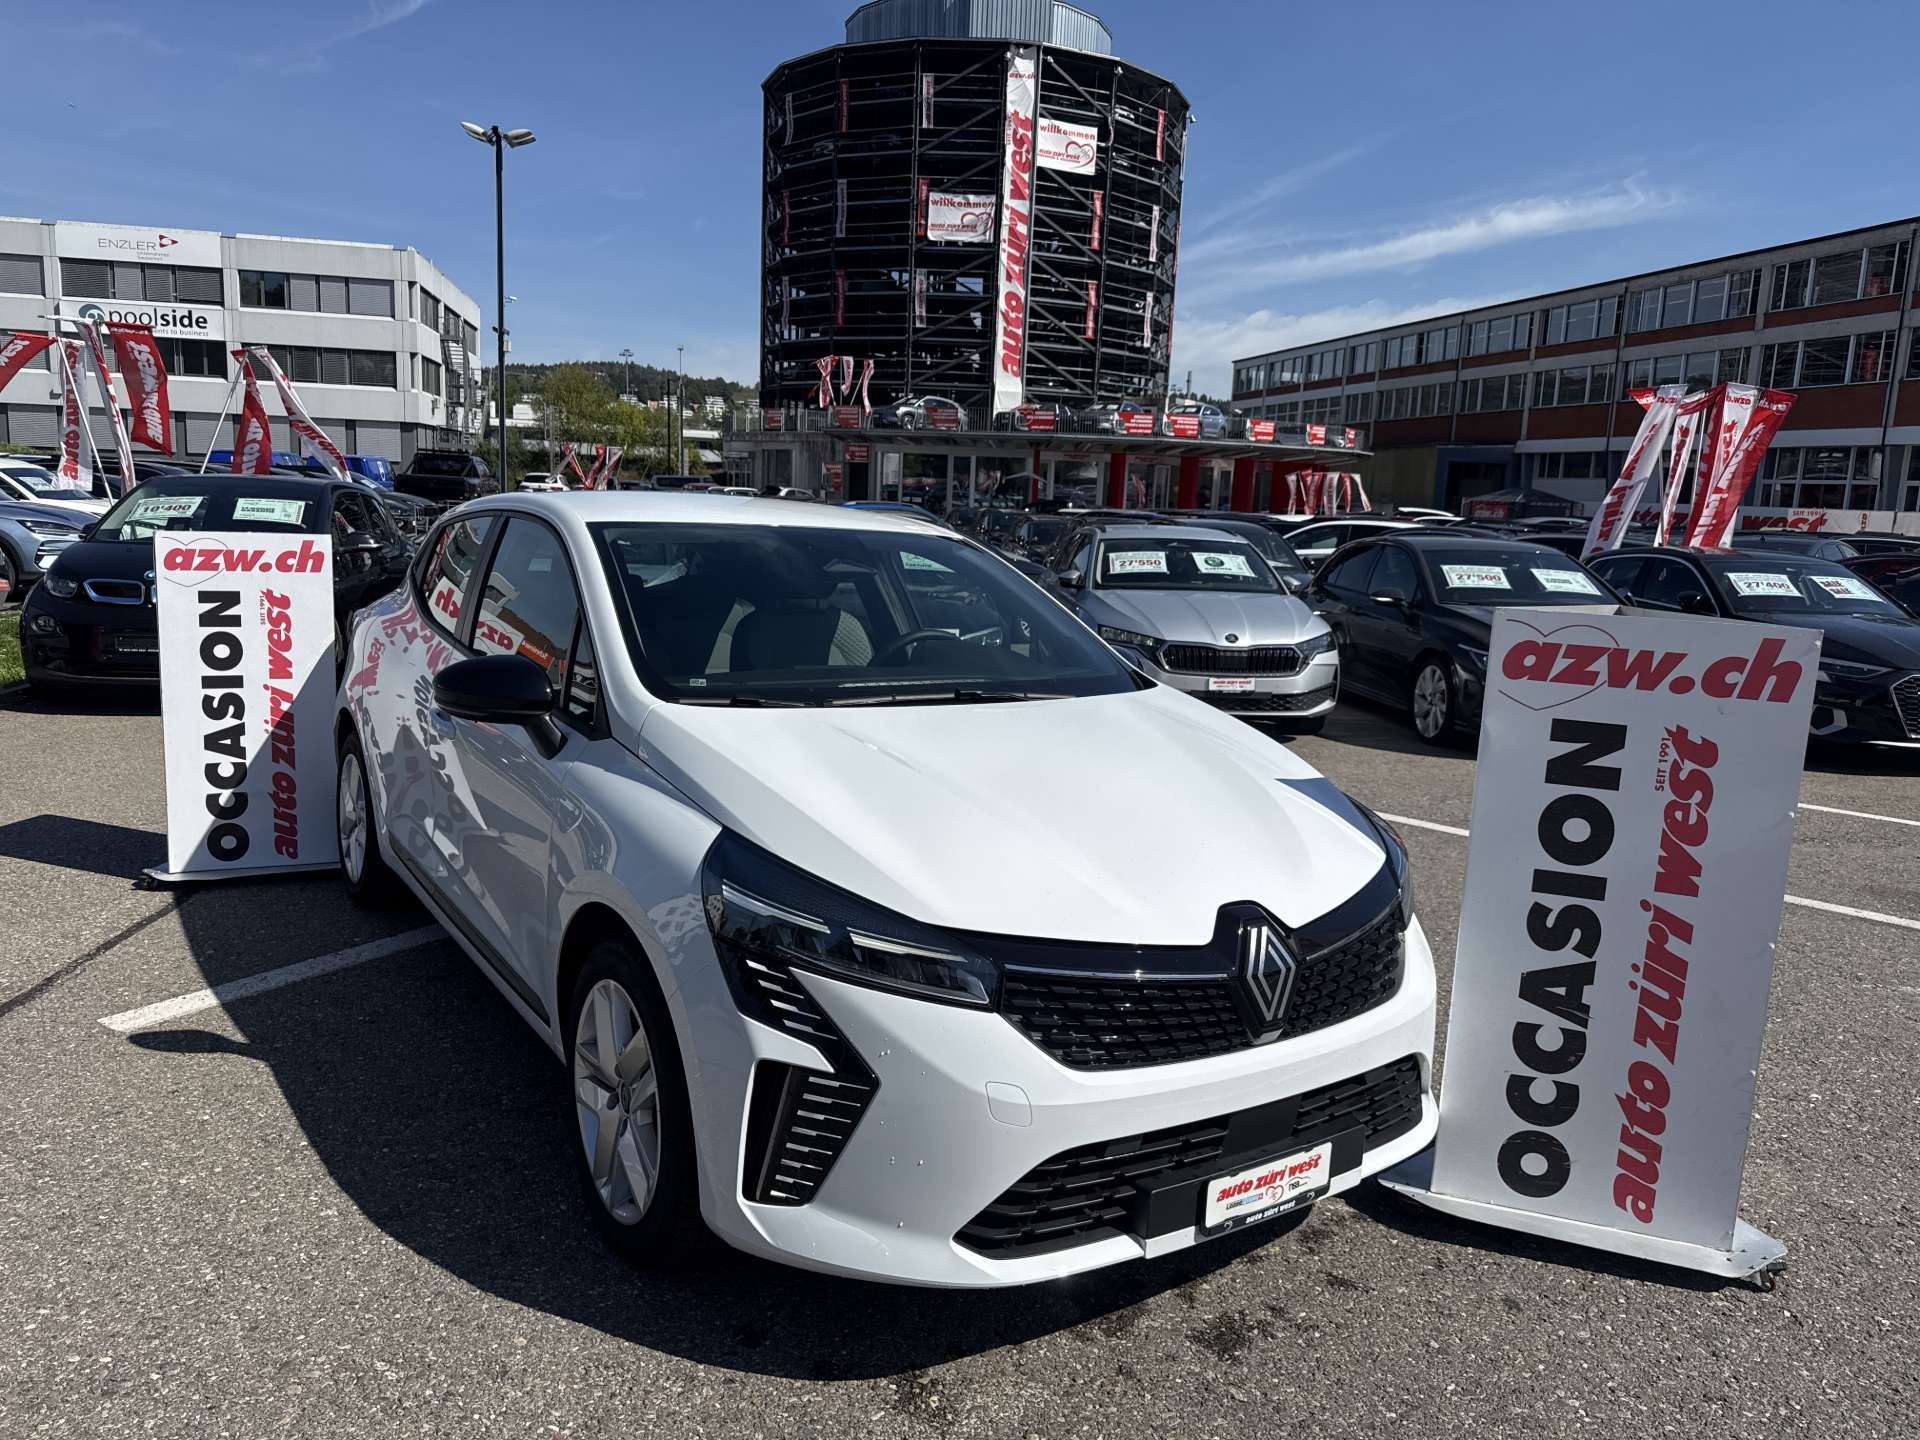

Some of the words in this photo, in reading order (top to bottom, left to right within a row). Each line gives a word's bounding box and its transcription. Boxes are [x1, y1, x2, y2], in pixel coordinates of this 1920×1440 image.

[1009, 109, 1033, 201] west
[1040, 123, 1096, 140] willkommen
[930, 196, 994, 209] willkommen
[98, 238, 157, 251] ENZLER
[1002, 203, 1029, 292] züri
[109, 308, 208, 329] poolside
[180, 329, 209, 337] business
[1001, 291, 1023, 378] auto
[63, 430, 80, 481] auto
[143, 504, 192, 514] 10'400
[163, 540, 325, 573] azw.ch
[1119, 559, 1162, 567] 27'550
[1455, 573, 1501, 582] 27'500
[1744, 581, 1791, 590] 27'400
[260, 588, 293, 679] west
[1501, 637, 1803, 704] azw.ch
[198, 590, 251, 862] OCCASION
[263, 684, 297, 770] züri
[1659, 737, 1671, 764] 1991
[1655, 767, 1667, 792] SEIT
[273, 770, 299, 860] auto
[1654, 723, 1718, 898] west
[1497, 718, 1628, 1198] OCCASION
[1628, 898, 1695, 1066] züri
[1613, 1061, 1671, 1224] auto
[1216, 1178, 1253, 1202] auto
[1255, 1165, 1287, 1189] züri
[1288, 1153, 1322, 1177] west
[1245, 1212, 1263, 1224] auto
[1279, 1200, 1296, 1212] west
